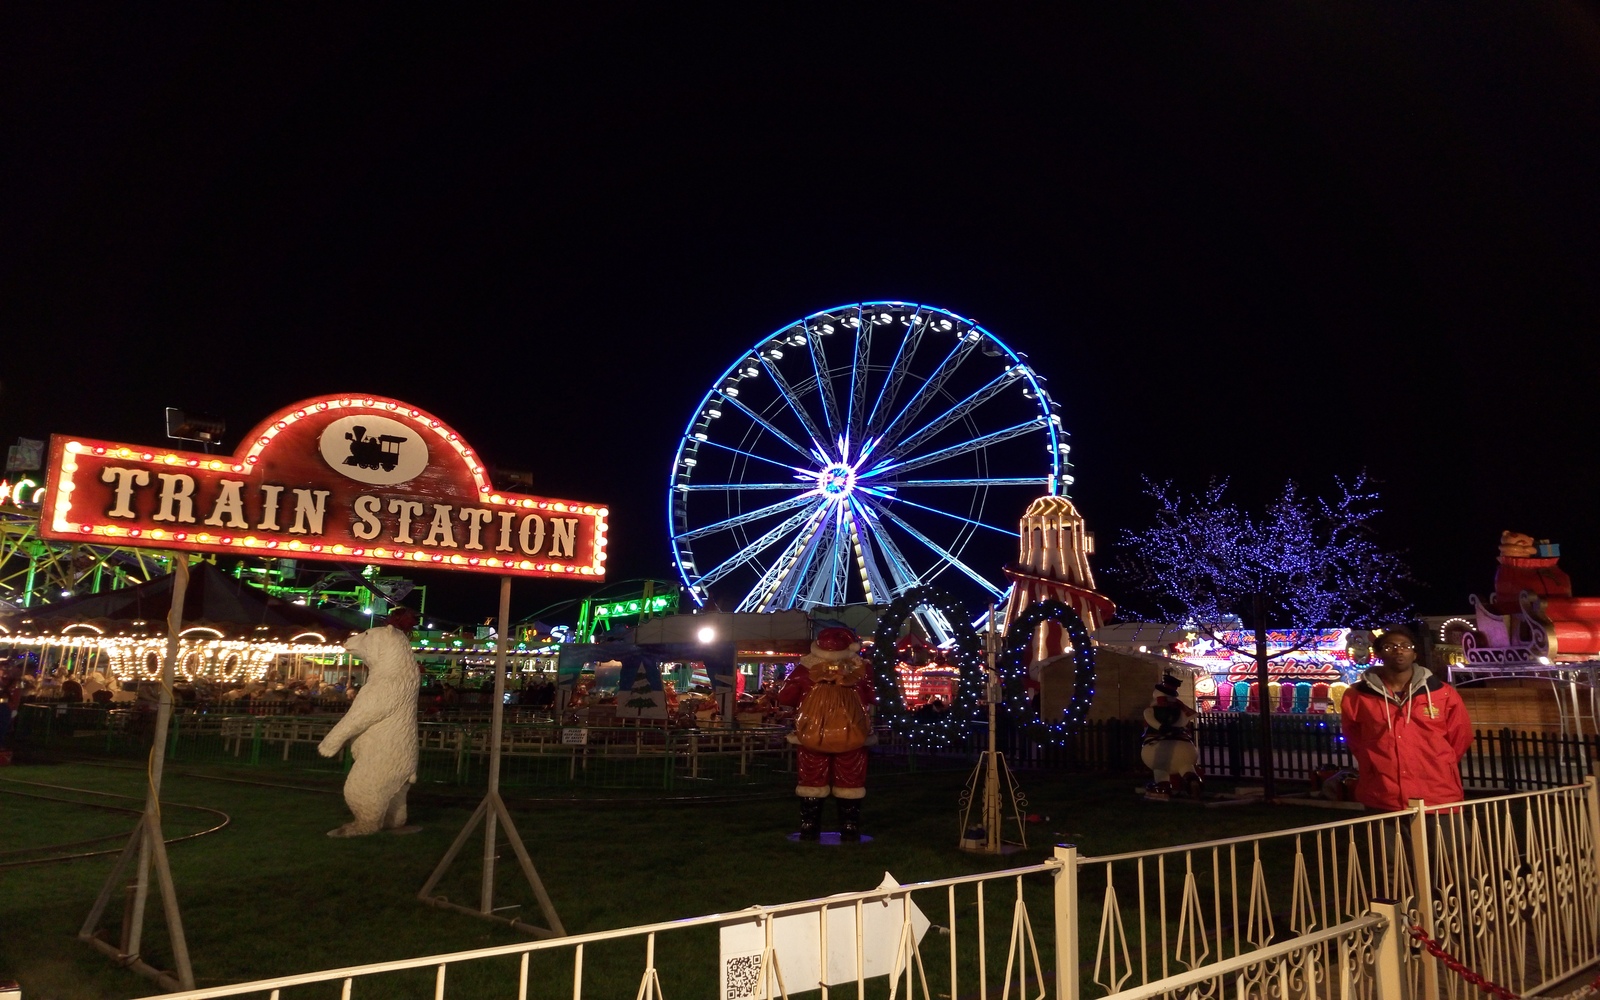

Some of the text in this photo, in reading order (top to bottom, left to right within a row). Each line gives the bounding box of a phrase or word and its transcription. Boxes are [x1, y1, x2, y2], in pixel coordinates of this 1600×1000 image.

[102, 466, 578, 558] TRAIN STATION
[1226, 658, 1341, 683] Slighride
